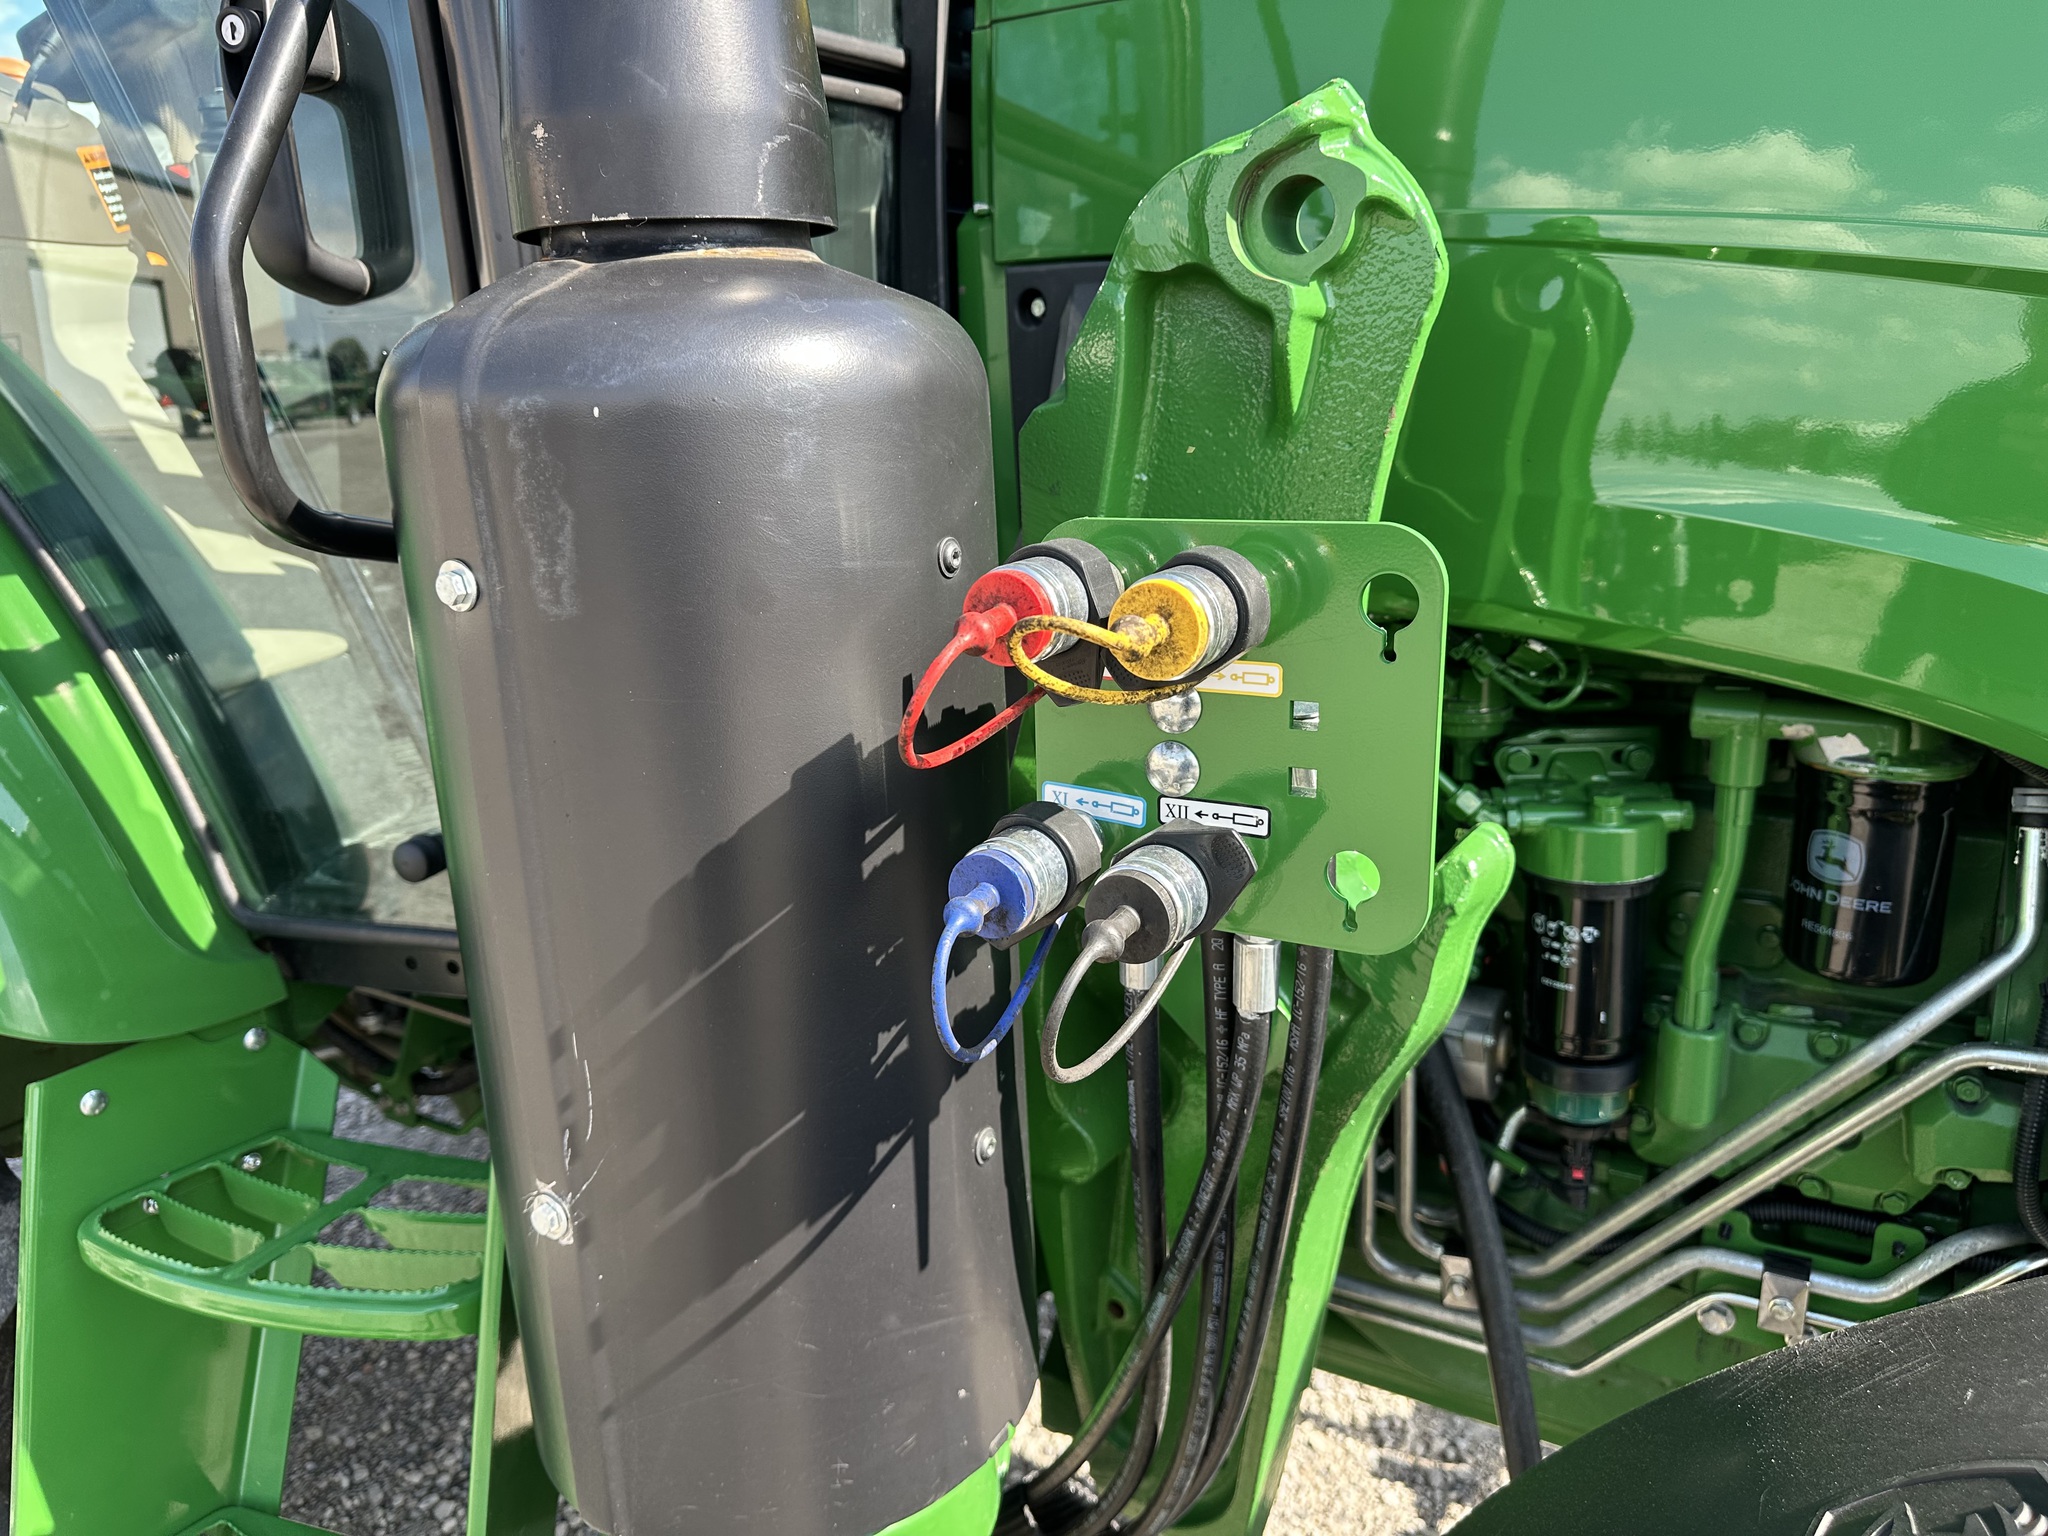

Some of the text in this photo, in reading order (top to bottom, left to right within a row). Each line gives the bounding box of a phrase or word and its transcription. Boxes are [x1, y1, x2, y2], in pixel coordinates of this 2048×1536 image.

[1052, 790, 1068, 806] XI
[1165, 803, 1189, 819] XII
[1825, 889, 1893, 914] DEERE
[1213, 976, 1226, 1000] TYPE
[1214, 1006, 1227, 1020] HF
[1237, 1032, 1251, 1053] MPa
[1234, 1053, 1247, 1071] 35
